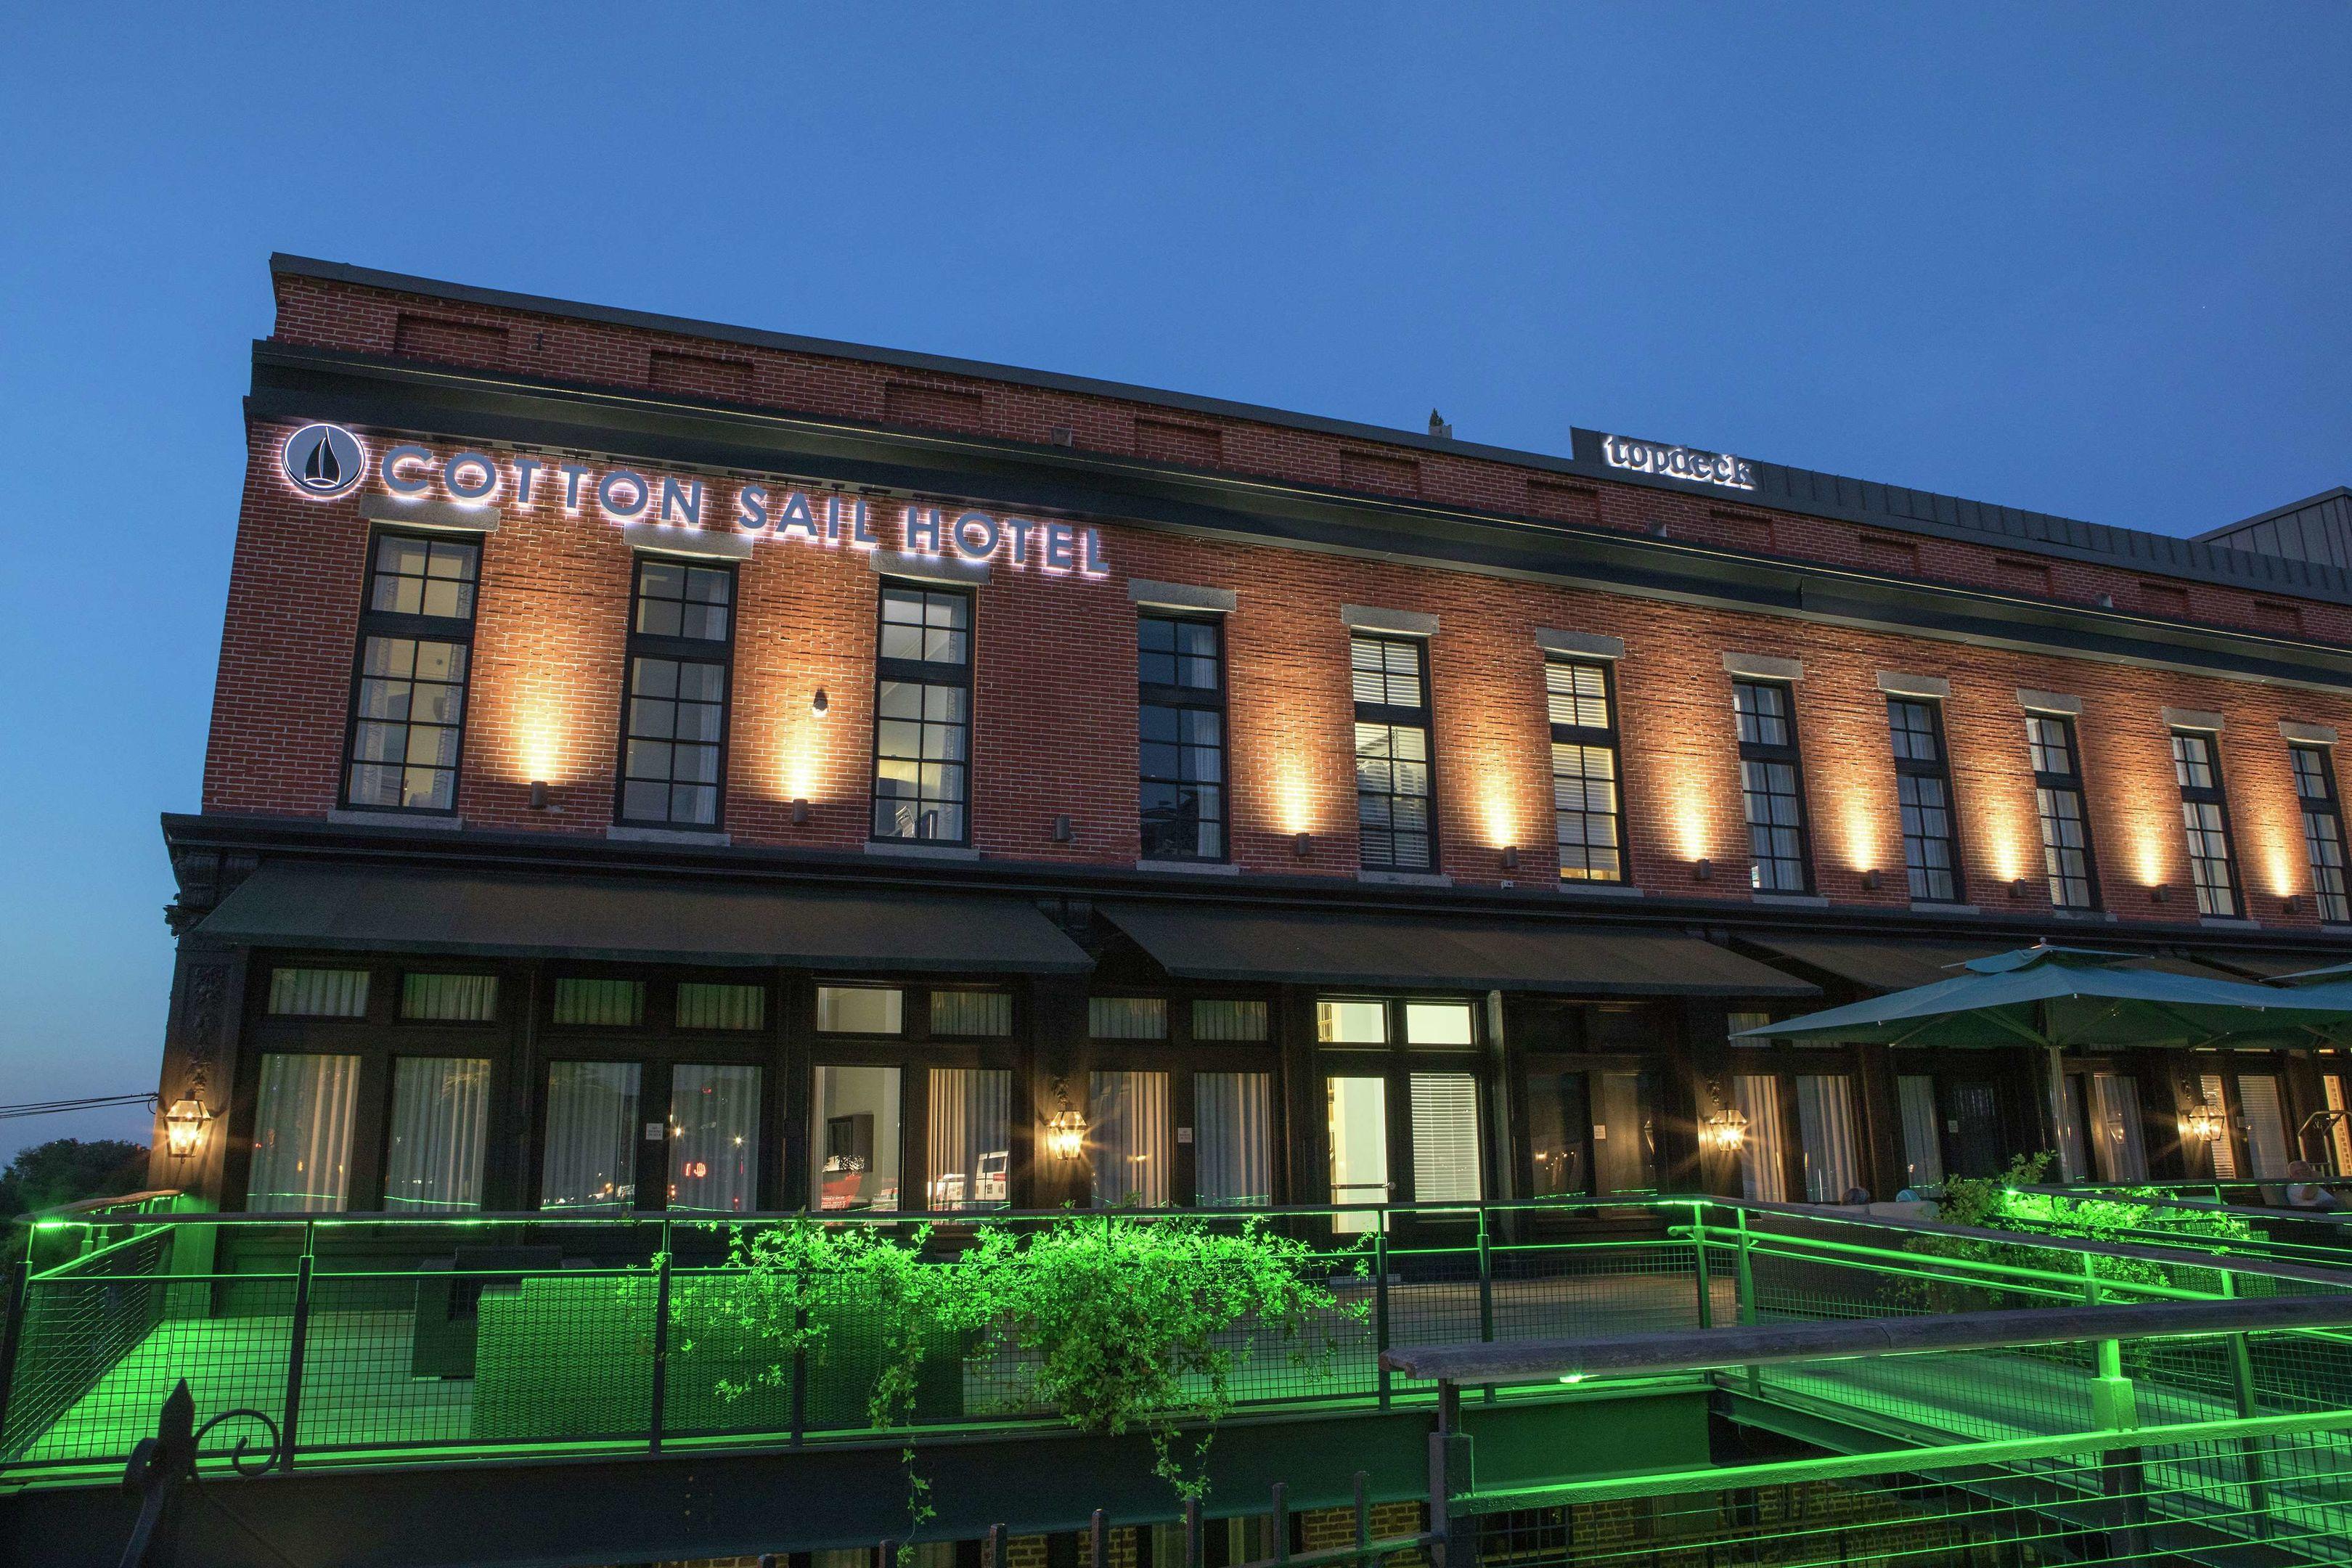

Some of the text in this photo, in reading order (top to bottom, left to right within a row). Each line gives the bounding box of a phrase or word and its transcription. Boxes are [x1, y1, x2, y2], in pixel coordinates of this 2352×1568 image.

[1605, 435, 1756, 488] topdeck
[382, 445, 1109, 574] COTTON SAIL HOTEL
